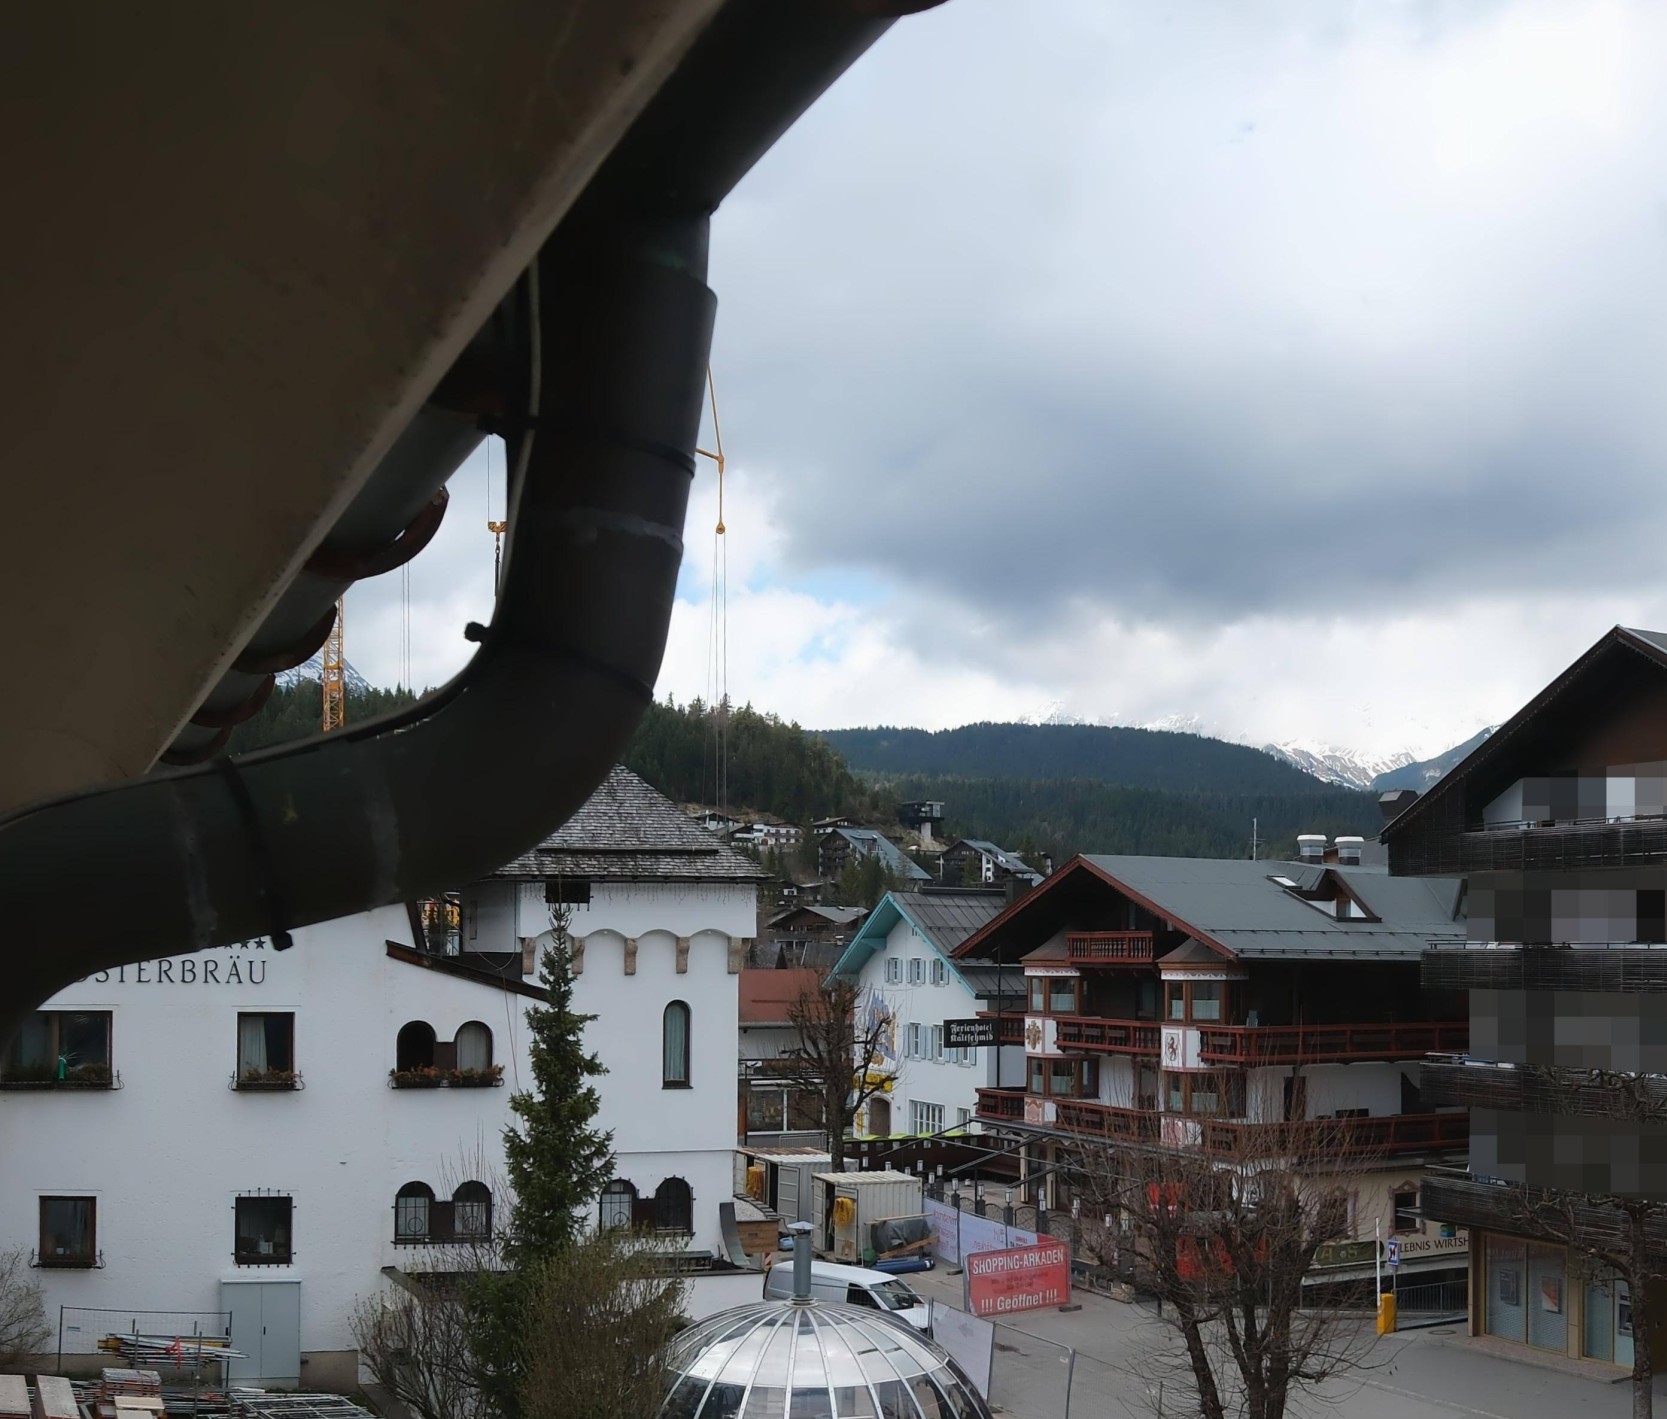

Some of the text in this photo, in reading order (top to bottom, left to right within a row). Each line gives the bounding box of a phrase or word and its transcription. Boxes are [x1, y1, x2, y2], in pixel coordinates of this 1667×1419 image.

[76, 955, 267, 984] STERBRÄU
[973, 1249, 1064, 1274] SHOPPING-ARKADEN
[997, 1291, 1043, 1311] Geöffnet
